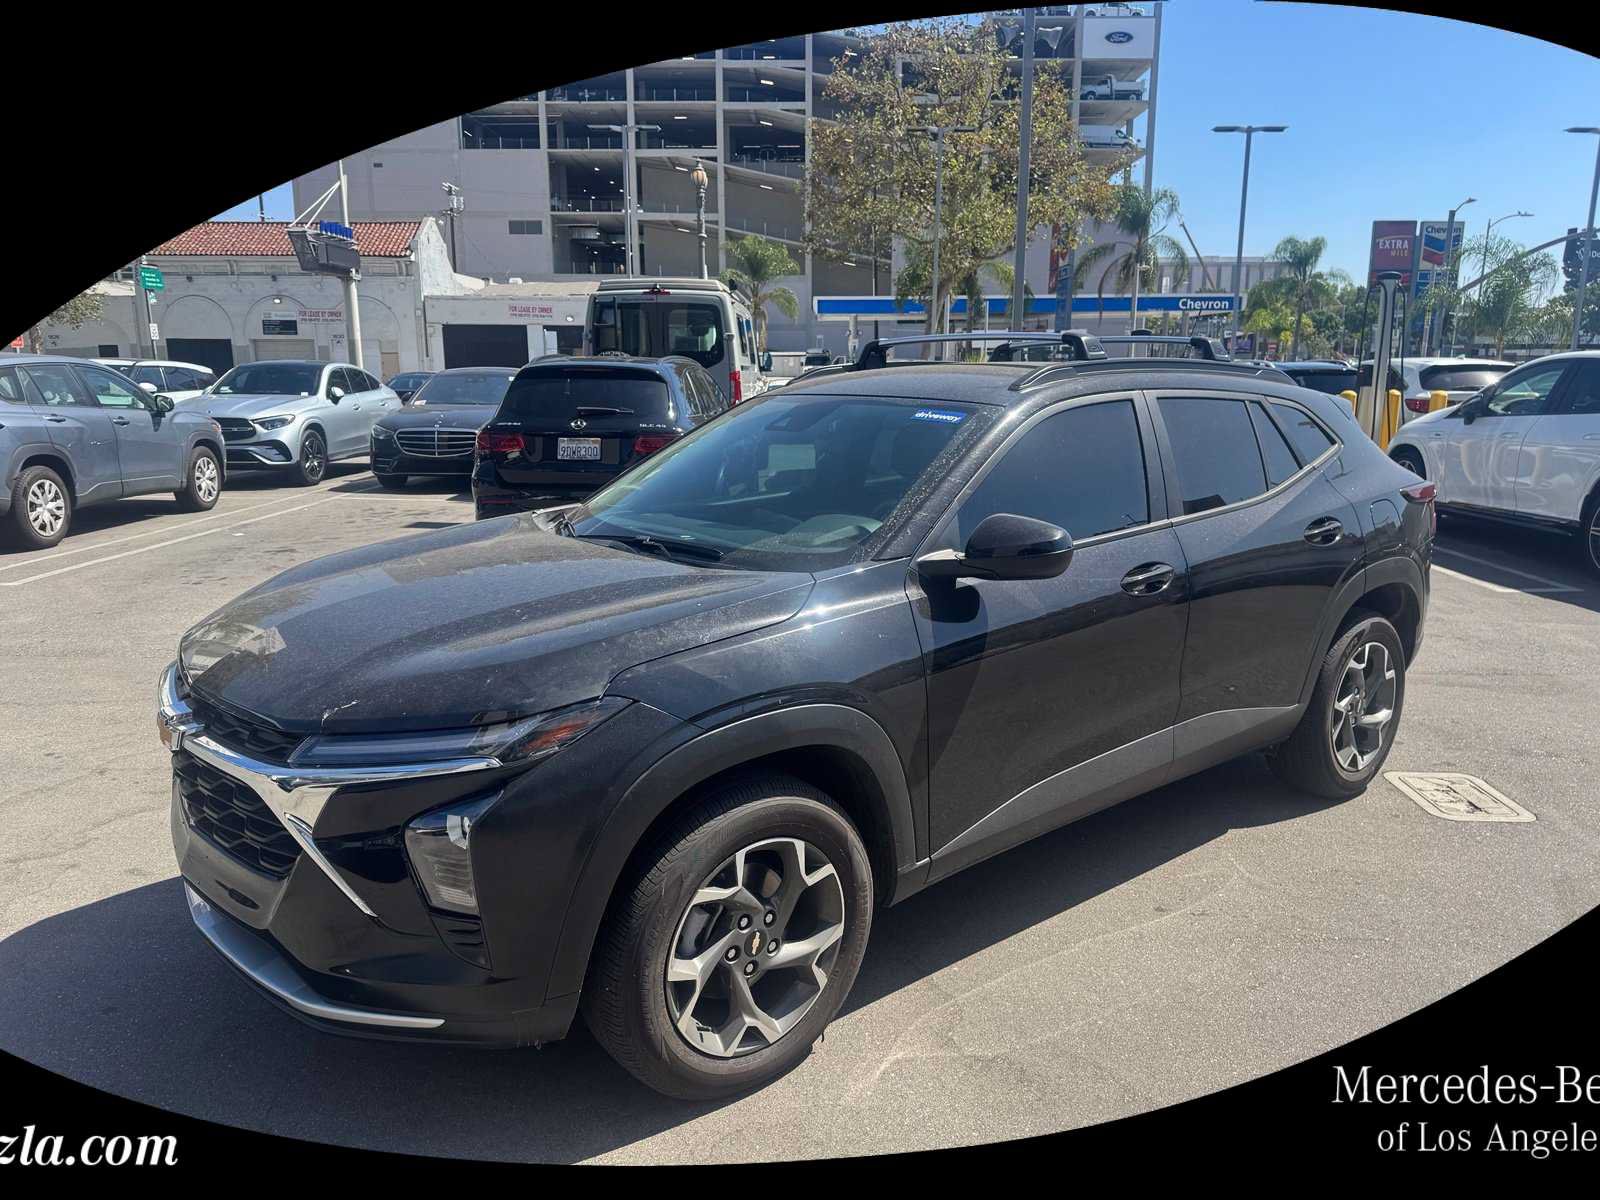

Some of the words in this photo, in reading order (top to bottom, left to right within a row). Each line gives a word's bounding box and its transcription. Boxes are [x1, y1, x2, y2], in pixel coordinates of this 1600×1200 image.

[1425, 225, 1462, 234] Chevn
[1379, 239, 1409, 249] EXTRA
[1178, 298, 1229, 310] Chevron
[915, 411, 962, 423] driveway
